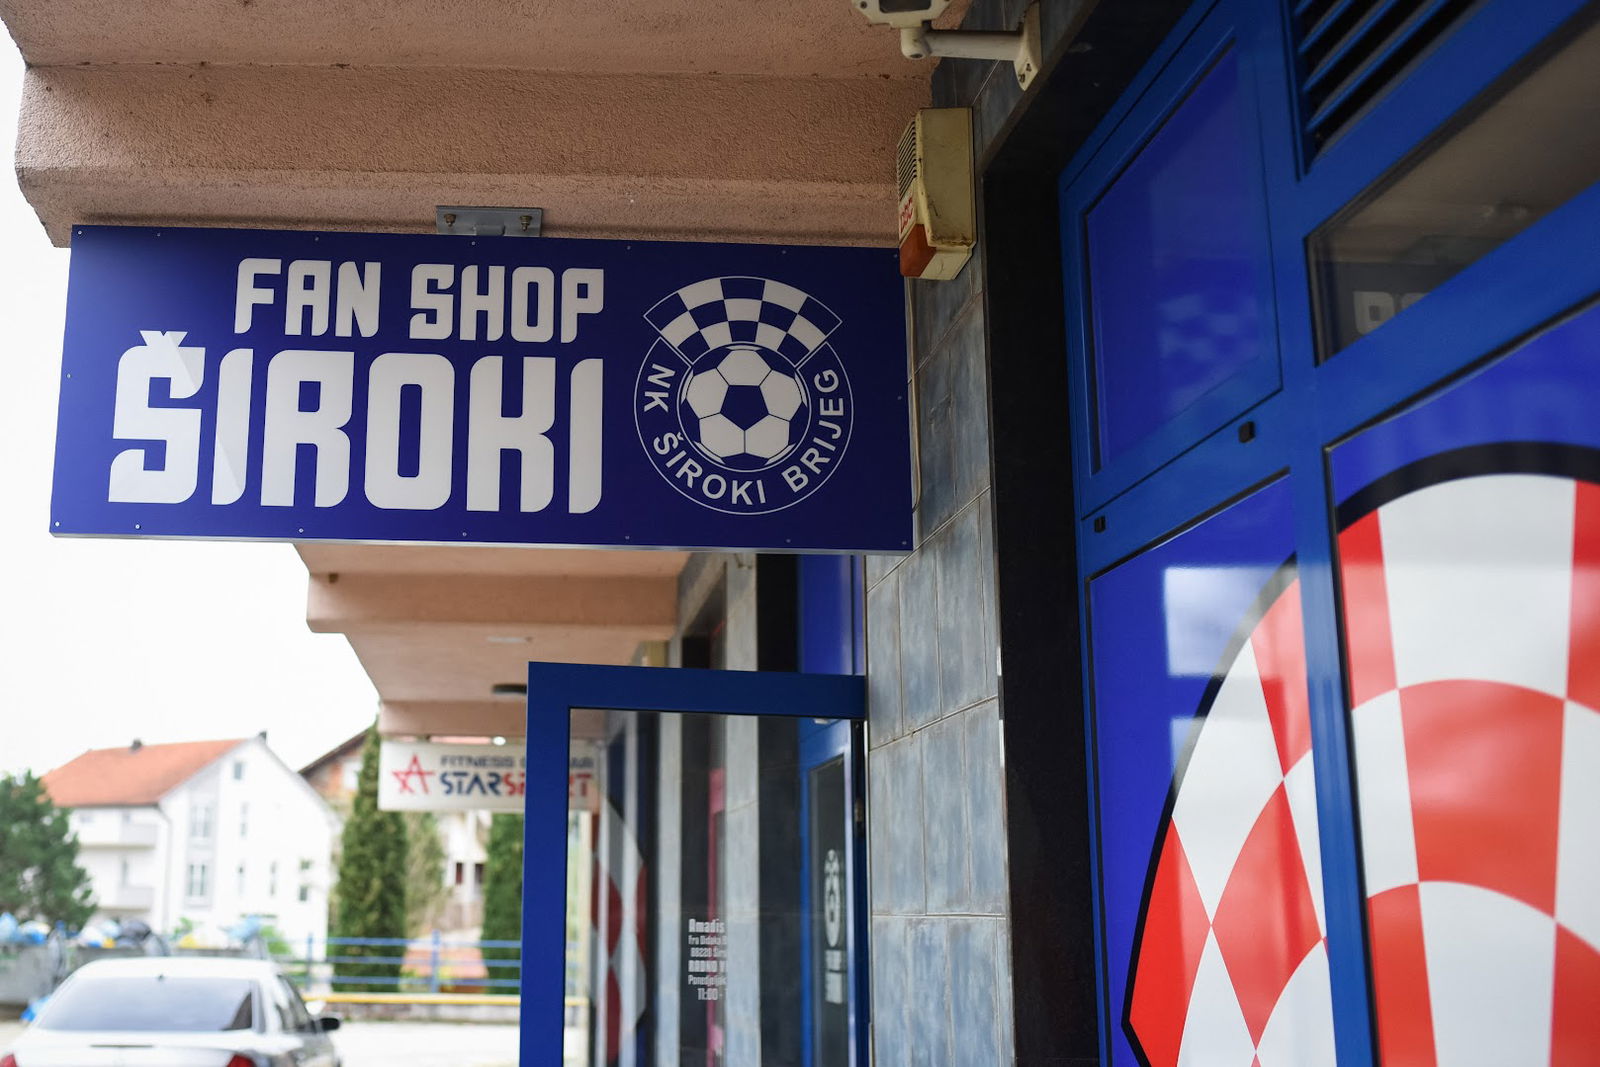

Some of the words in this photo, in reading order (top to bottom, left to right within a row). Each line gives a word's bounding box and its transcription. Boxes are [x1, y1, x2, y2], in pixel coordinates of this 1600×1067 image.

[234, 258, 381, 337] FAN
[409, 263, 604, 343] SHOP
[108, 330, 604, 514] ŠIROKI
[644, 363, 676, 413] NK
[653, 431, 766, 505] ŠIROKI
[781, 369, 844, 493] BRIJEG
[440, 771, 592, 797] STARST
[697, 988, 718, 1000] 11:00
